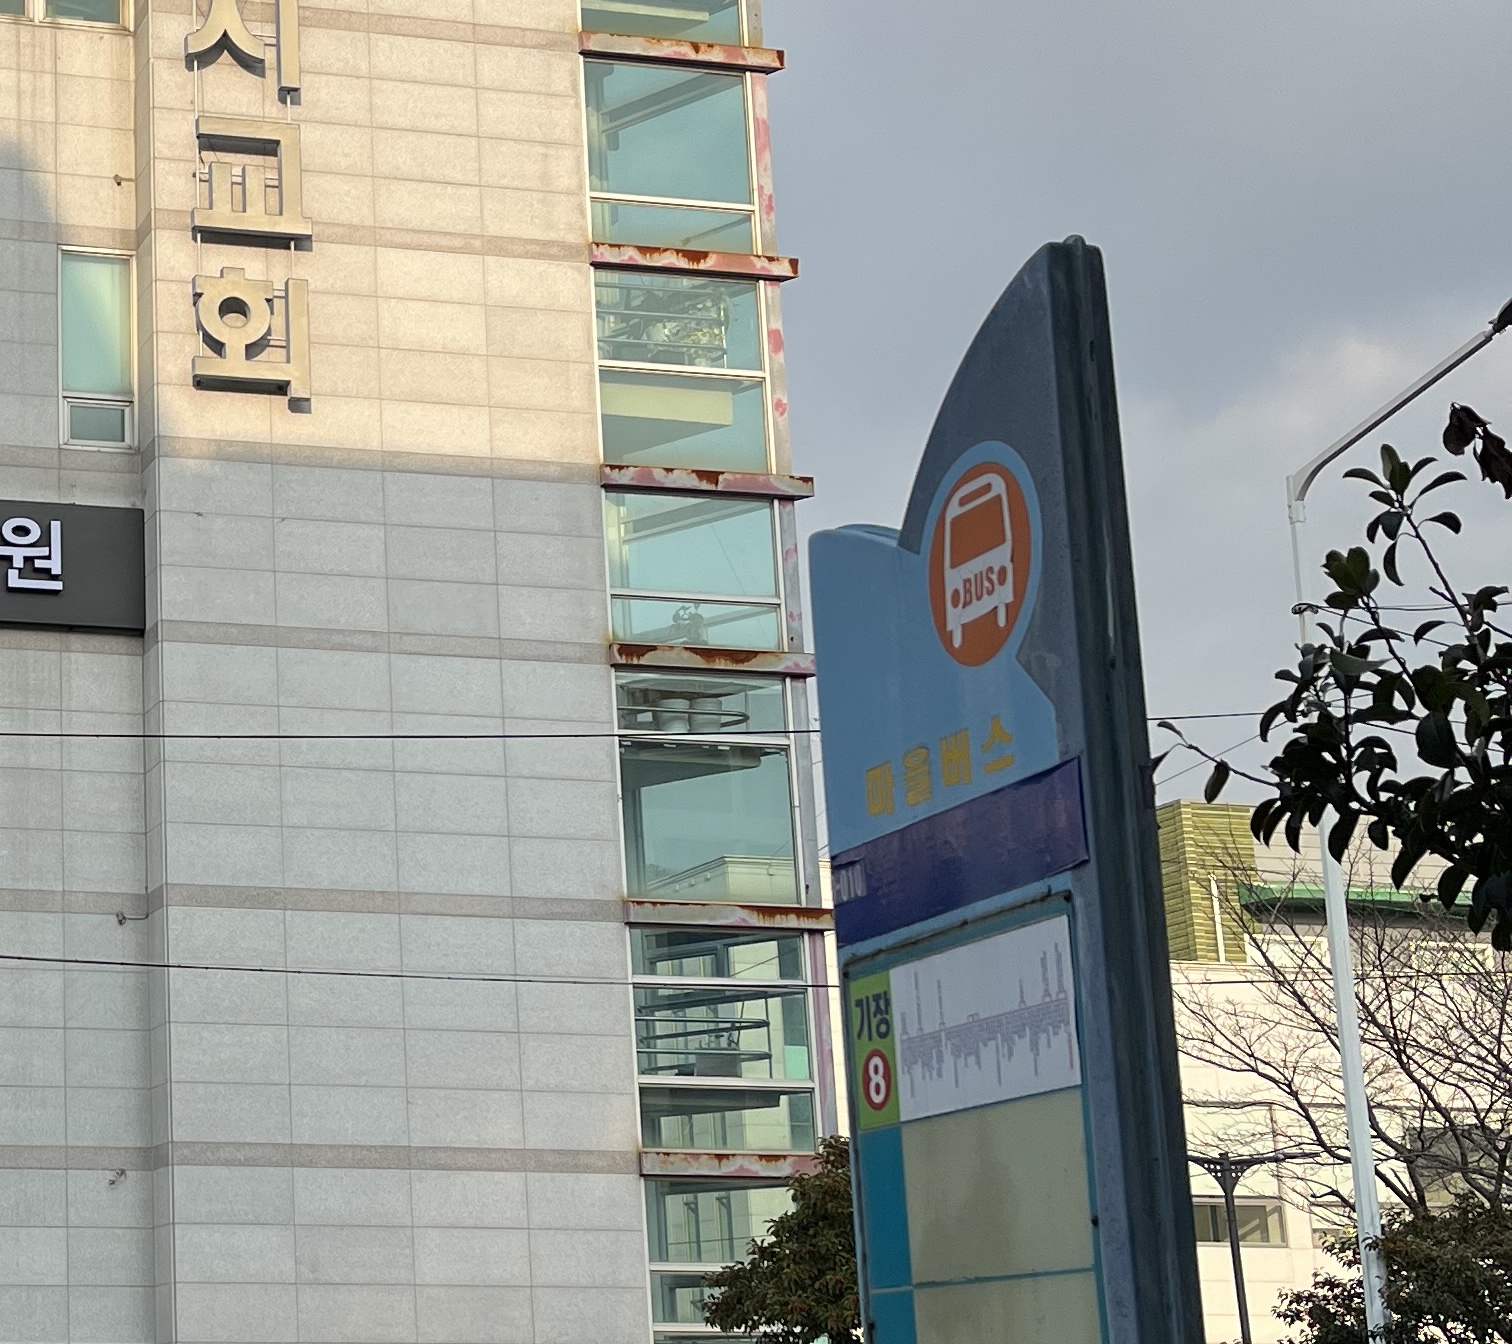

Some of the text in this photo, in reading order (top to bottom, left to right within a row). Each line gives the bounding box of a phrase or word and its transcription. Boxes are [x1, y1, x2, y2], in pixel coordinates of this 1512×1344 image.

[962, 567, 995, 609] BUS
[865, 714, 1016, 817] 마을버스
[854, 990, 892, 1042] 기장
[868, 1055, 887, 1105] 8
